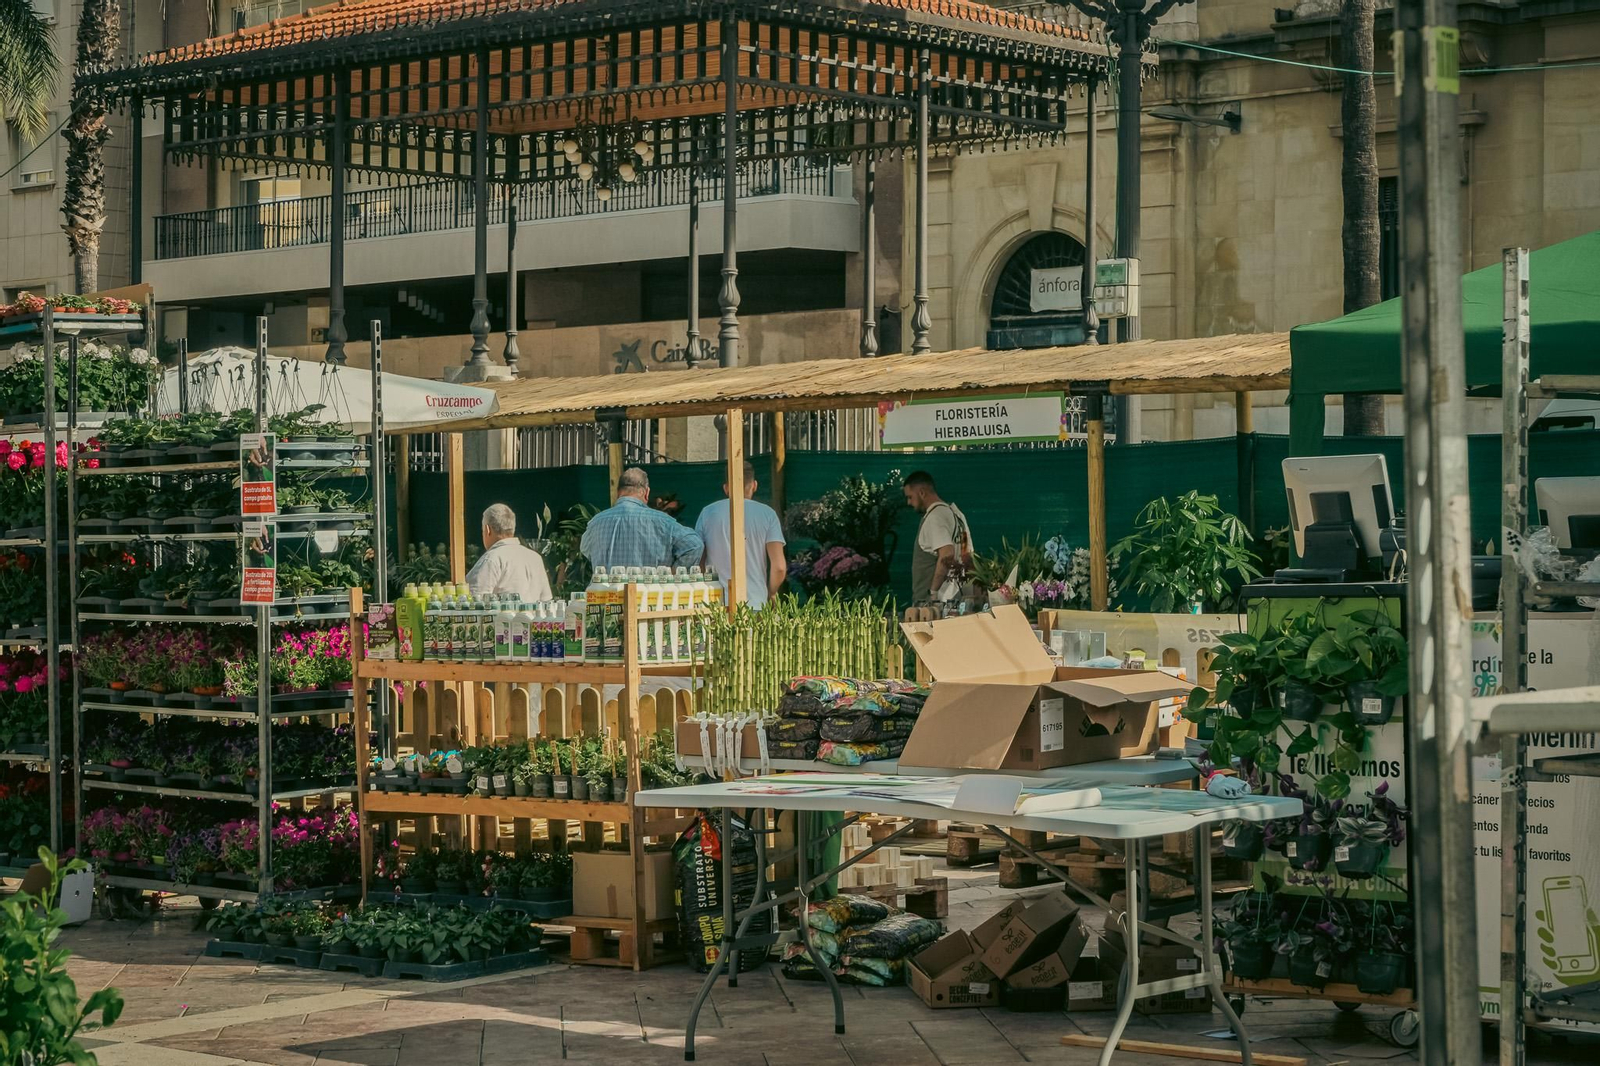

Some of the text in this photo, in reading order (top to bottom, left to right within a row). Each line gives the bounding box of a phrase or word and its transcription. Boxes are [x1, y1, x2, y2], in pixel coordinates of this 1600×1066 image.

[1038, 276, 1080, 294] ánfora
[650, 339, 741, 363] CaixBa
[425, 394, 483, 409] Cruzcampo
[935, 403, 1008, 421] FLORISTERÍA
[934, 423, 1012, 439] HIERBALUISA
[1541, 649, 1553, 664] la
[1042, 722, 1063, 733] 617195
[1472, 793, 1555, 808] cáner ecios
[1472, 820, 1548, 835] entos enda
[1480, 846, 1489, 856] tu
[1529, 848, 1571, 862] favoritos
[695, 845, 707, 908] SUBSTRATO
[704, 844, 717, 907] UNIVERSAL
